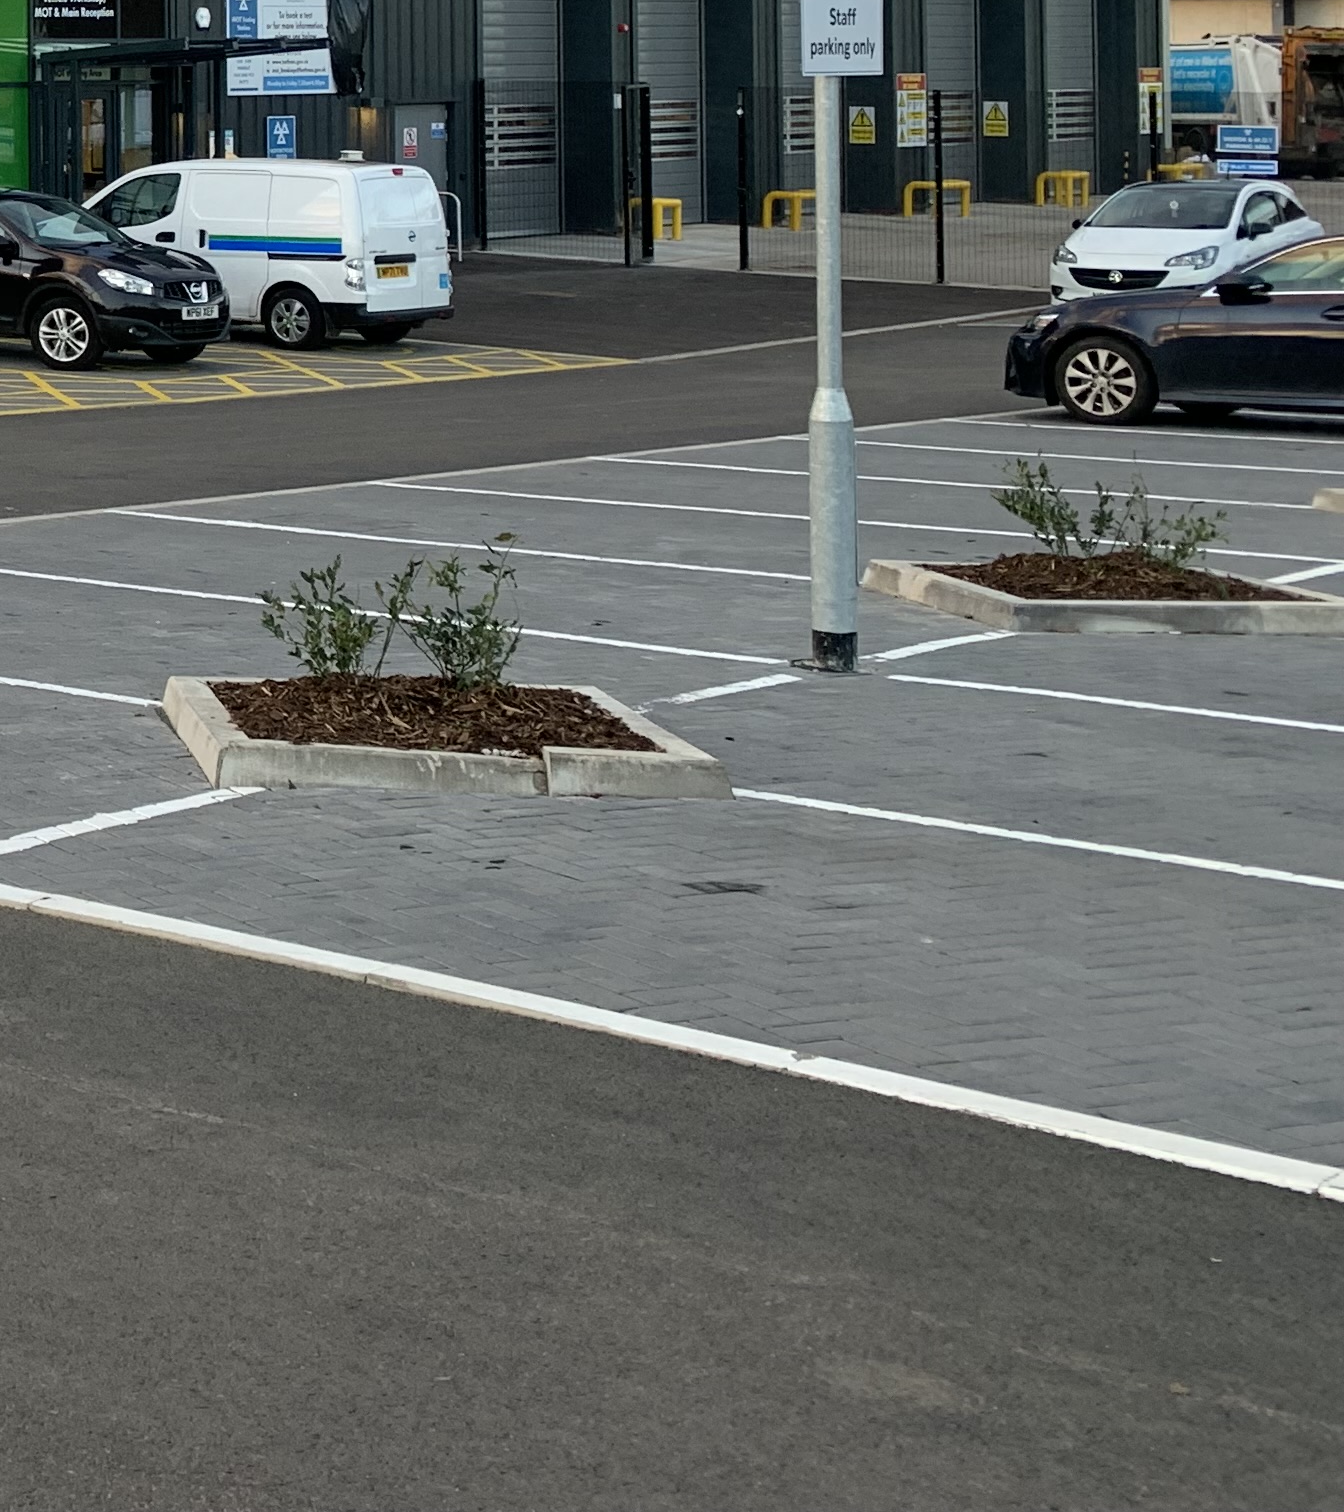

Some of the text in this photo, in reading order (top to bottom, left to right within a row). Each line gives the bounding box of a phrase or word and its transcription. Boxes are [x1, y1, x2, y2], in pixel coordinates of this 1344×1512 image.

[34, 6, 115, 20] MOT & Main Reception
[285, 10, 298, 19] book
[304, 11, 313, 19] test
[829, 7, 857, 26] Staff
[273, 21, 281, 29] for
[810, 37, 876, 60] parking only
[202, 306, 215, 317] XEF
